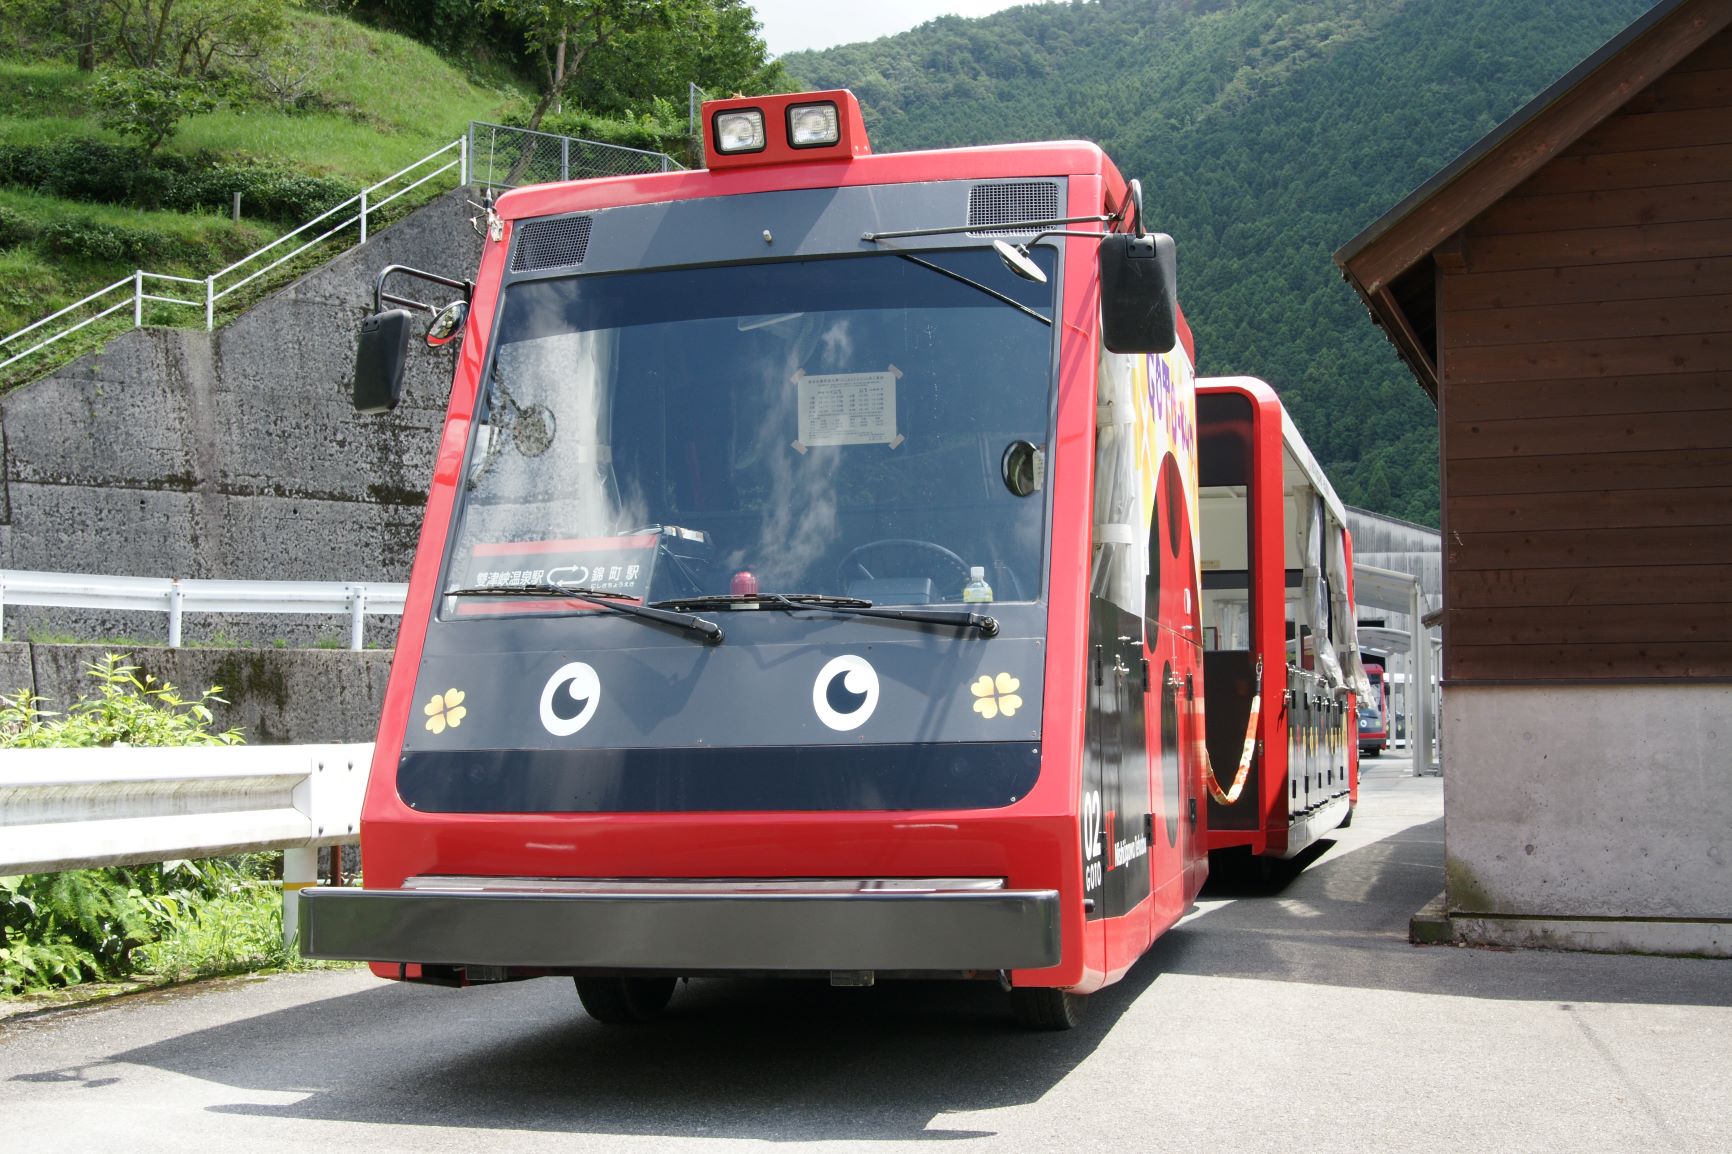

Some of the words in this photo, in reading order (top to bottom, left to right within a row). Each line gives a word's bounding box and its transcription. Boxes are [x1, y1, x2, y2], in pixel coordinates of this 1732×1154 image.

[591, 565, 640, 582] 錦町駅
[1084, 790, 1101, 861] 02
[1086, 861, 1102, 892] GOTO
